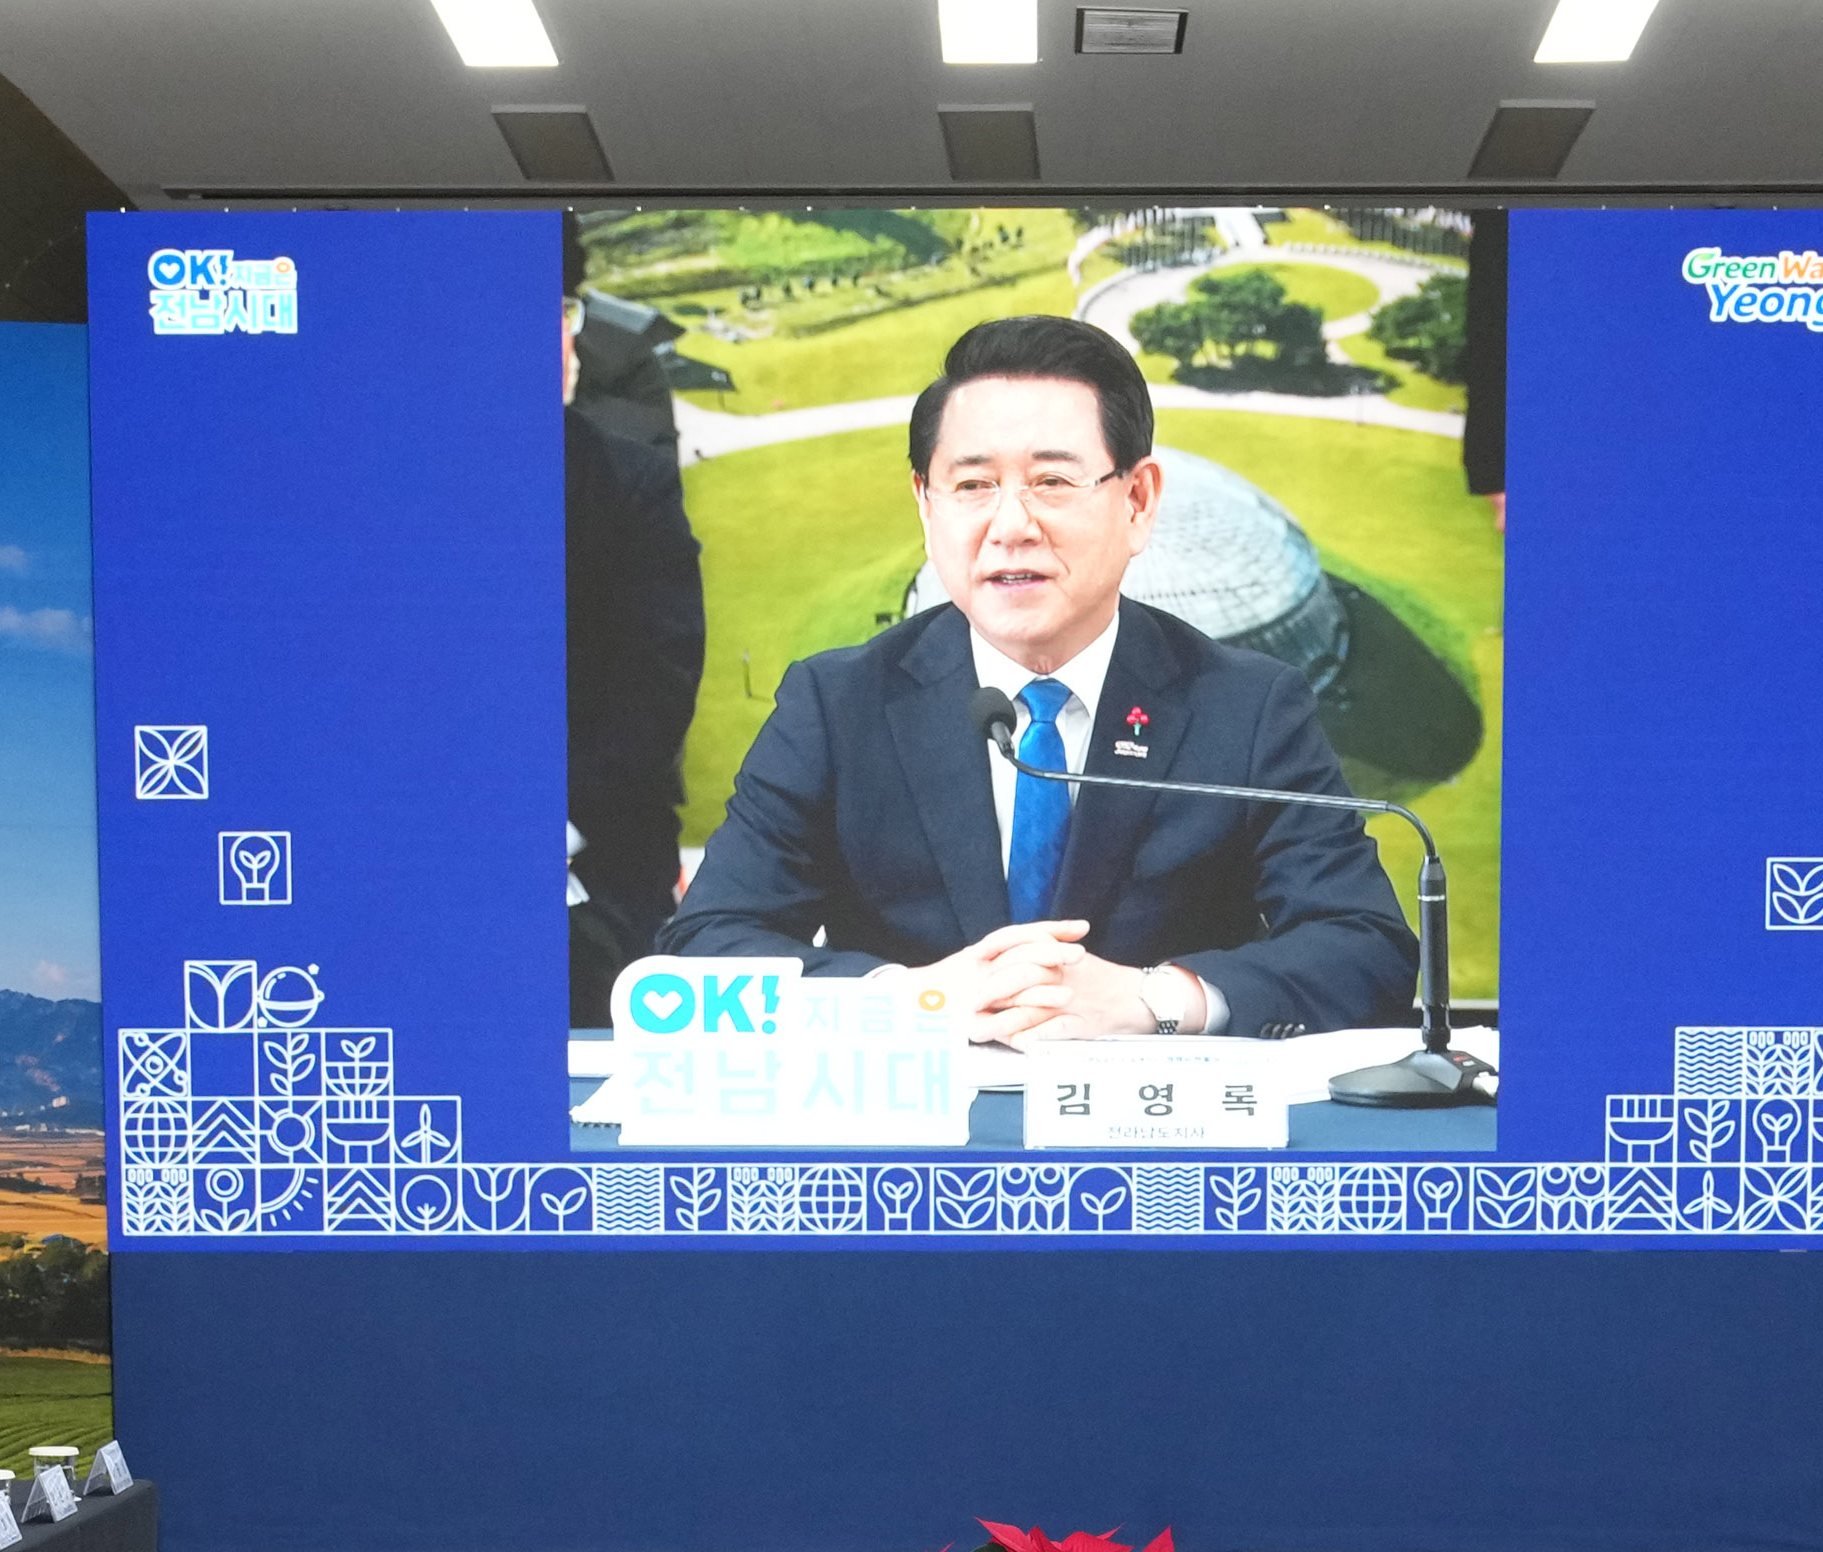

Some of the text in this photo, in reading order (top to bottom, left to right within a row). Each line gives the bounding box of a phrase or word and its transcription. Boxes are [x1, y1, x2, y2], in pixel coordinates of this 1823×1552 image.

[153, 253, 295, 287] OK! 지금은
[1688, 252, 1776, 280] Green
[151, 291, 297, 332] 전남시대
[629, 972, 951, 1035] OK! 지금은
[631, 1049, 951, 1117] 전남시대
[1107, 1126, 1206, 1140] 전라남도지사
